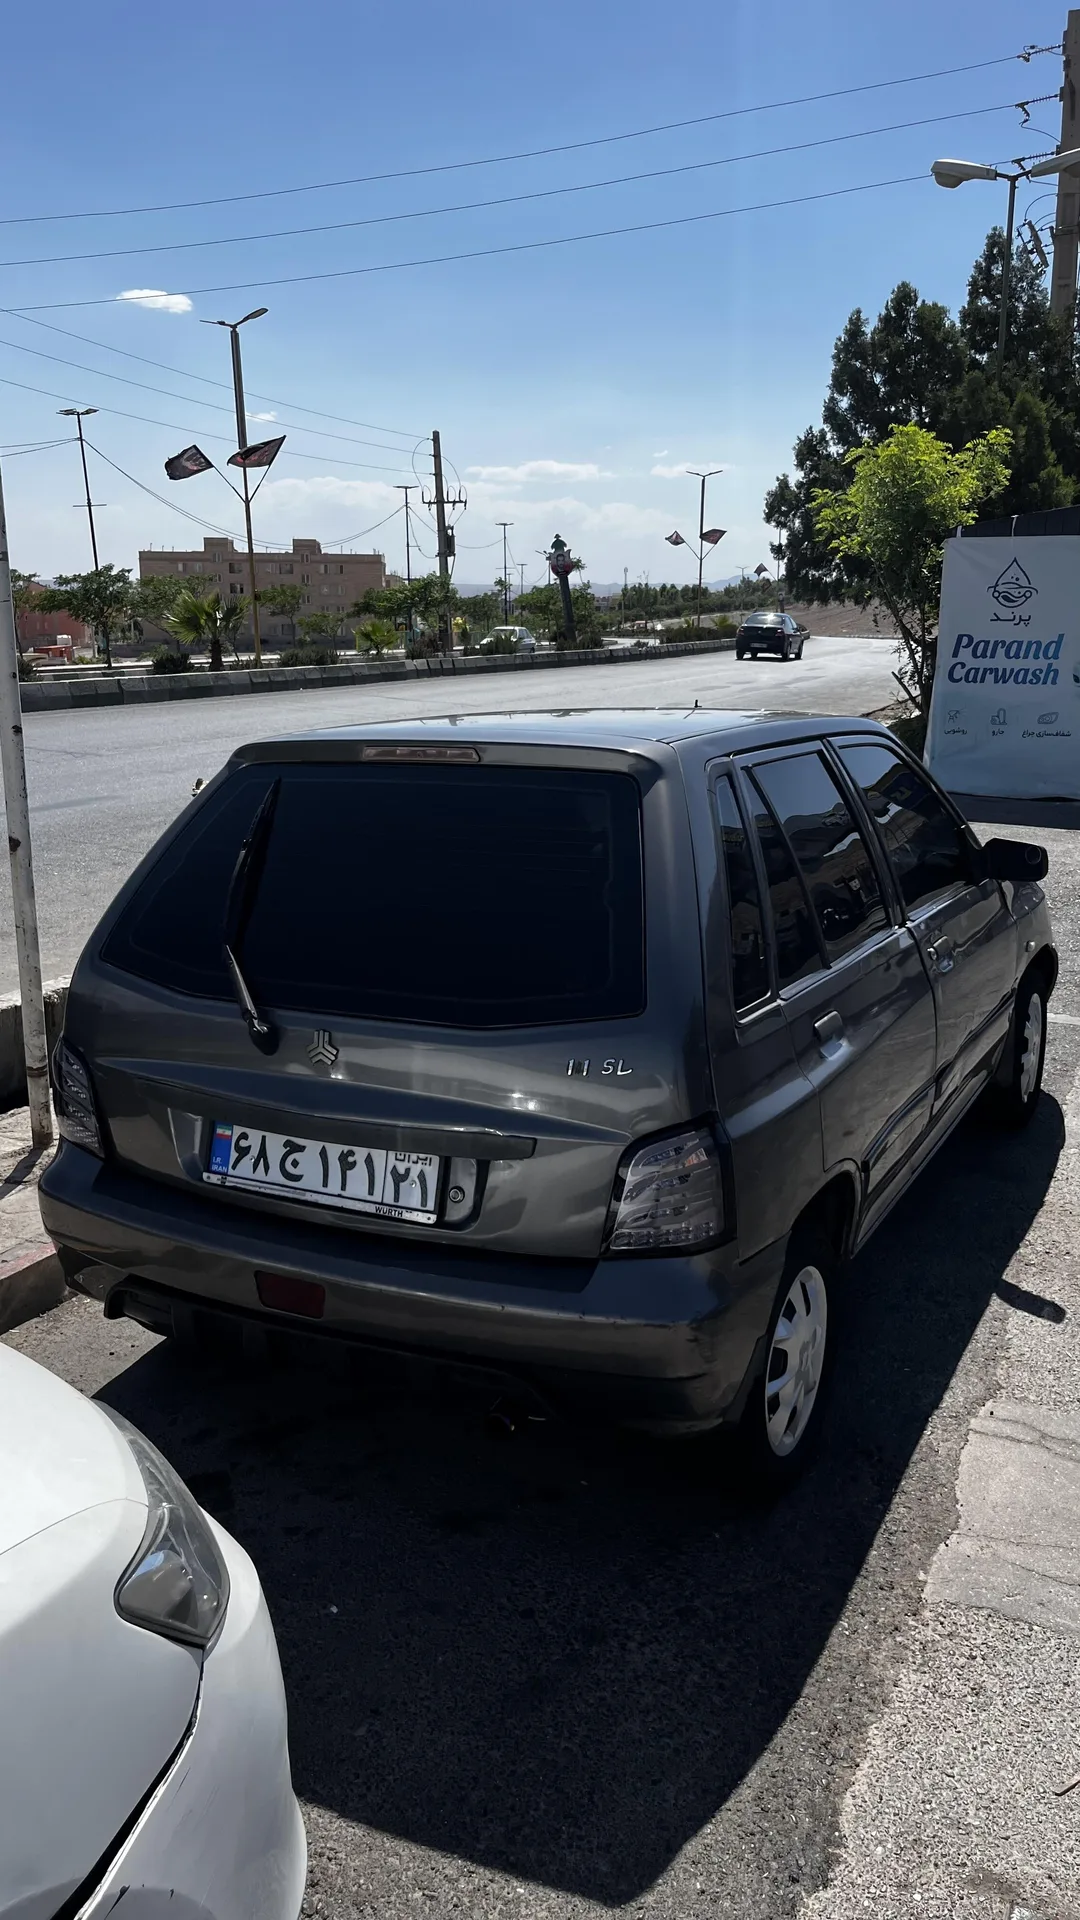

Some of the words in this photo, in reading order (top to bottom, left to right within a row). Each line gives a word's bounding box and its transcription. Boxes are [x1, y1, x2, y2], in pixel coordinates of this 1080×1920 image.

[990, 611, 1031, 627] پرند
[952, 633, 1065, 660] Parand
[947, 661, 1060, 685] Carwash
[601, 1058, 633, 1076] SL
[394, 1152, 433, 1167] ایران
[211, 1163, 228, 1174] IRAN
